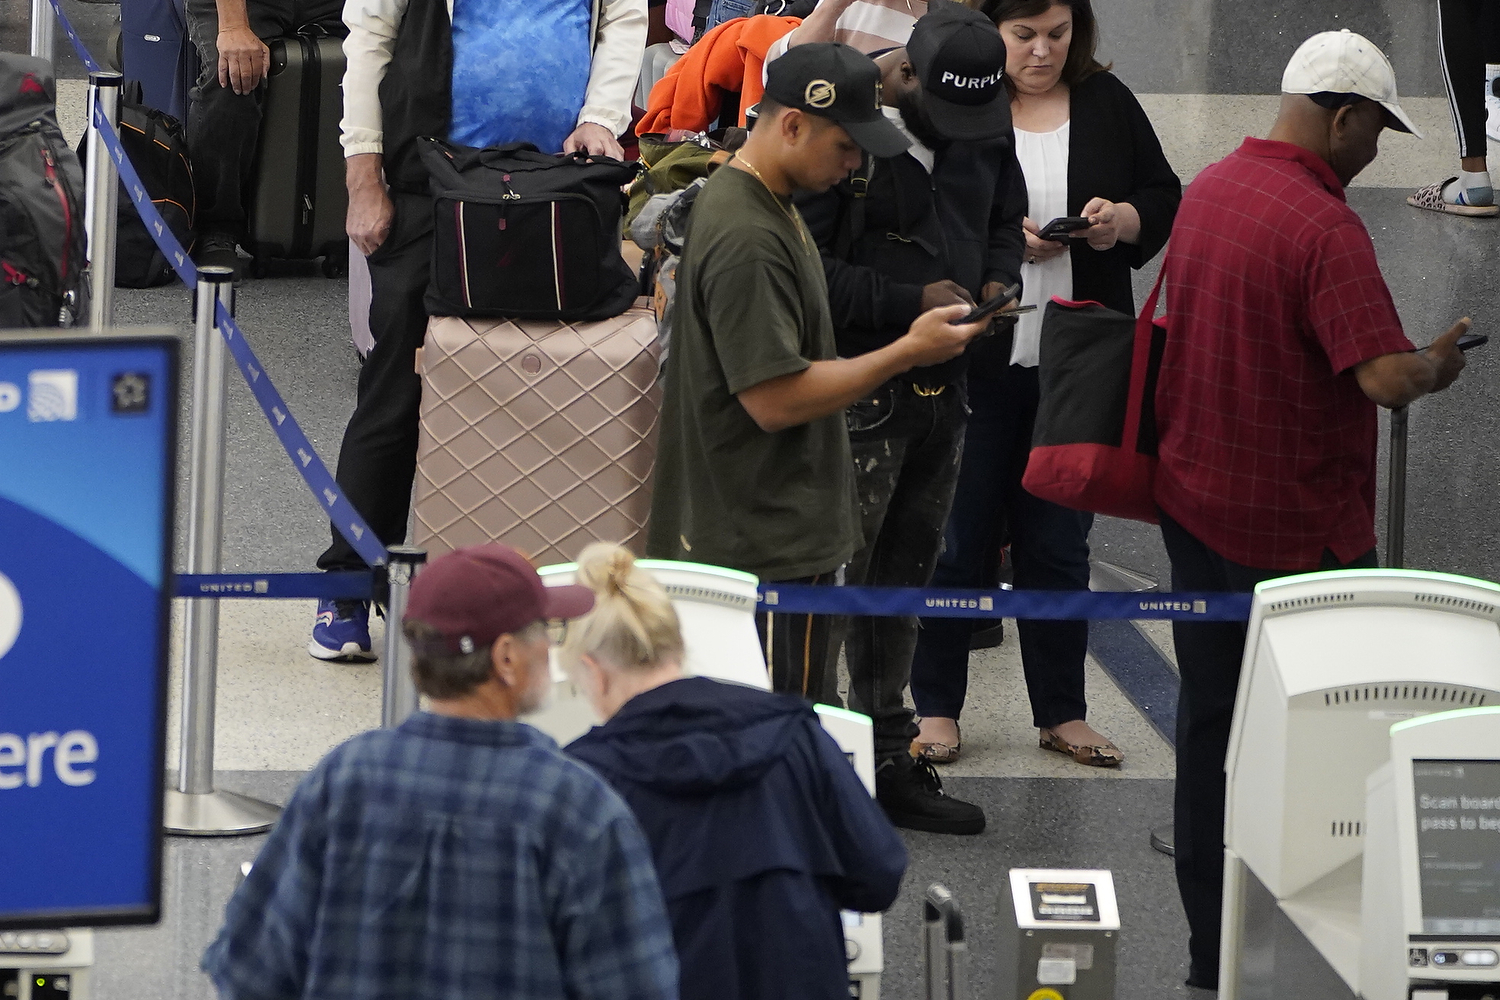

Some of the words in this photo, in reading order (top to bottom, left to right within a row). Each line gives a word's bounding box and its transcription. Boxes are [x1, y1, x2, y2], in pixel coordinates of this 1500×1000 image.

[941, 67, 1004, 89] PURPLE
[200, 584, 253, 592] UNITED
[925, 598, 978, 609] UNITED
[1139, 602, 1192, 611] UNITED
[1420, 794, 1457, 810] Scan
[1421, 817, 1457, 832] pass
[1460, 815, 1477, 830] to
